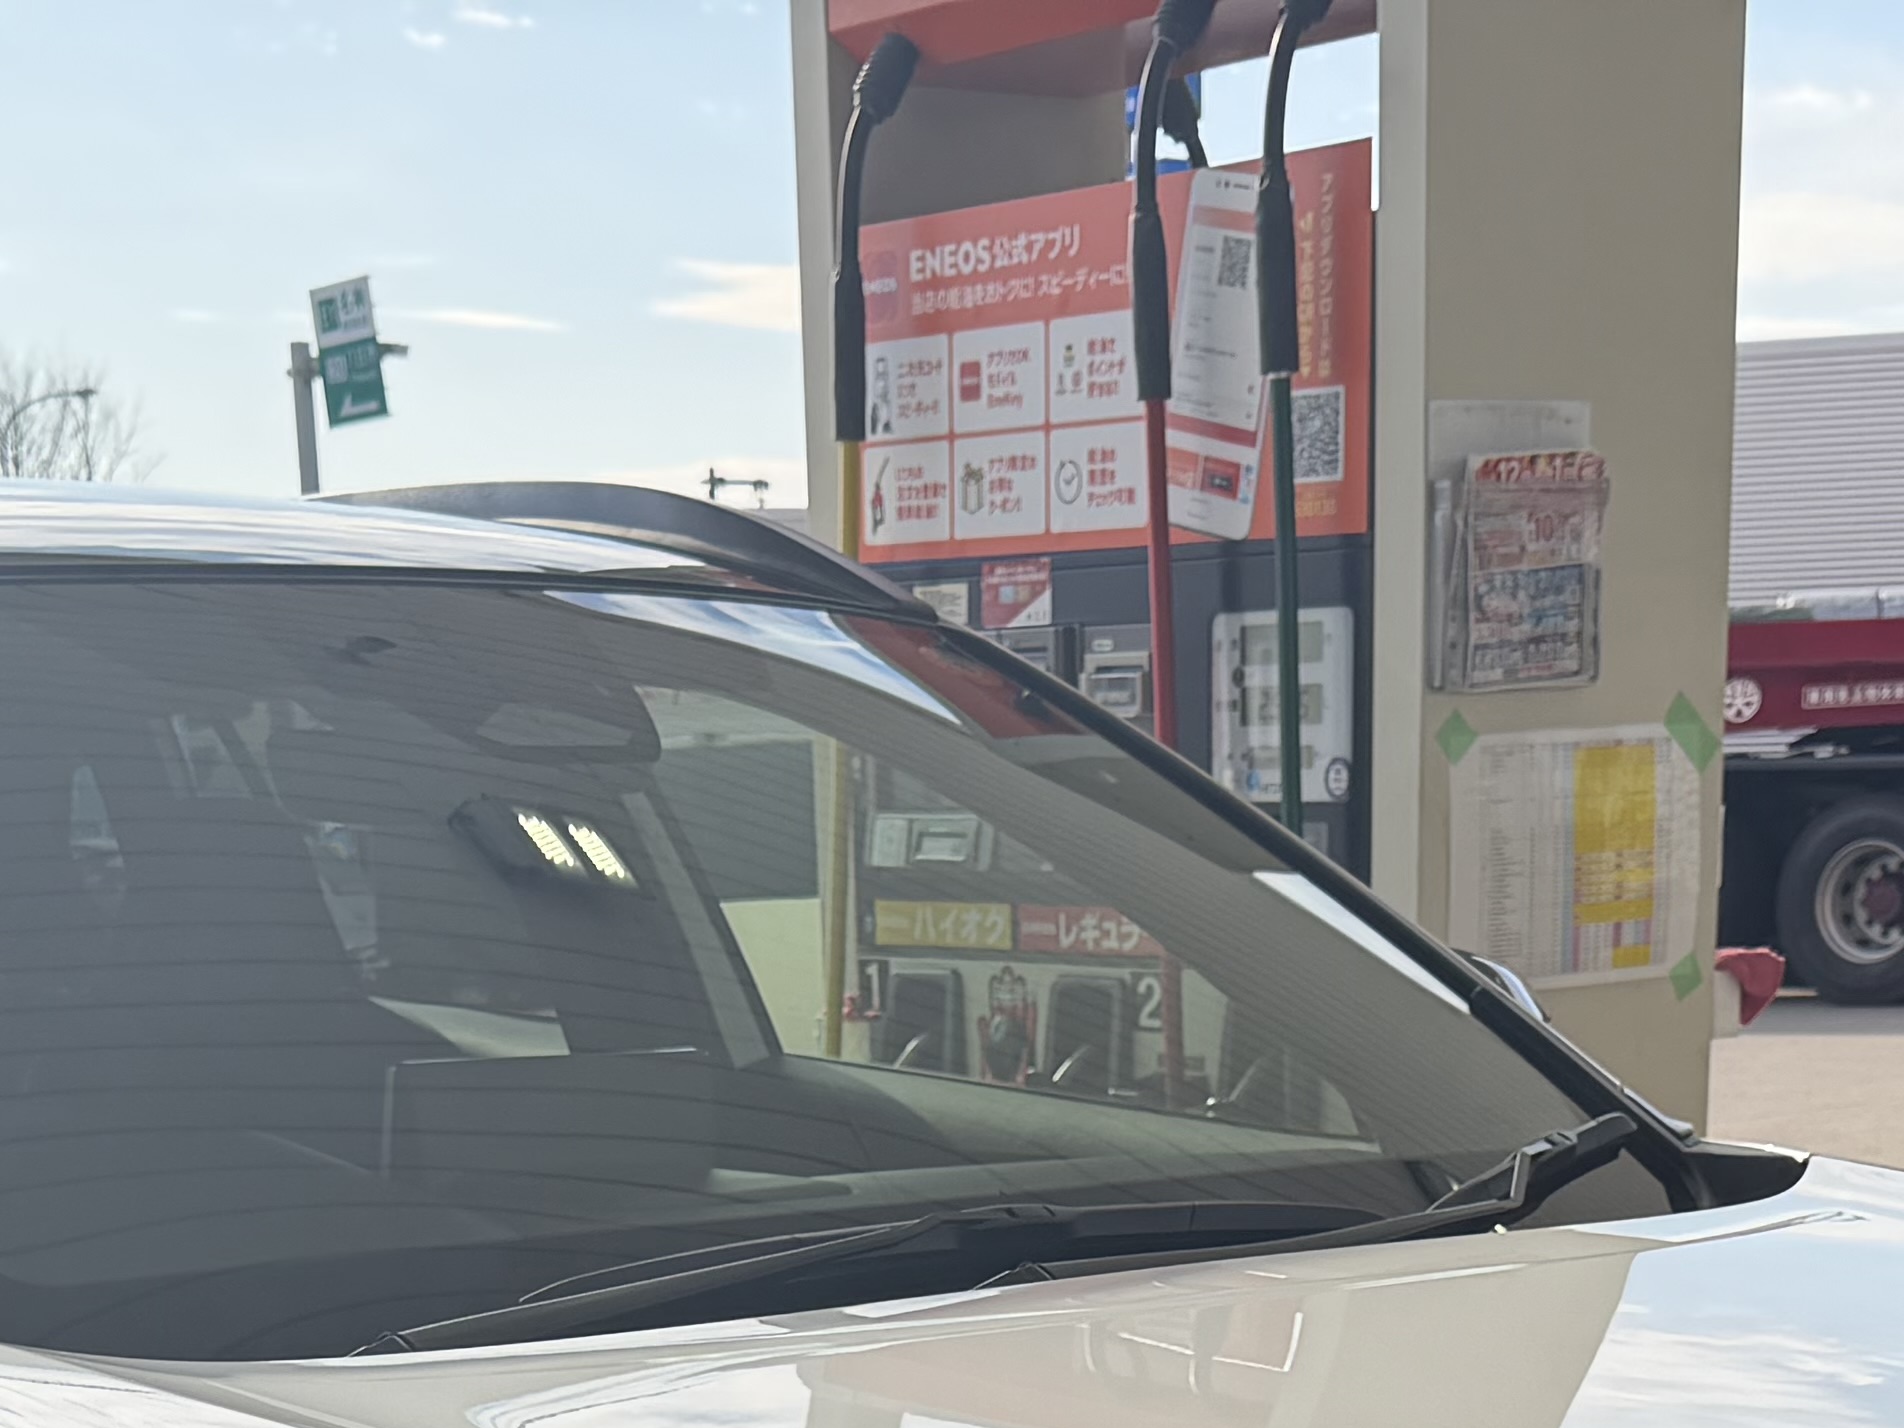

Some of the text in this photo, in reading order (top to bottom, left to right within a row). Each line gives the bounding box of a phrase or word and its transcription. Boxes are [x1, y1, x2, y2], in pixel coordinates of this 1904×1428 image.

[913, 905, 1007, 945] ハイオク
[1058, 910, 1150, 950] レギュラ
[1136, 976, 1163, 1029] 2
